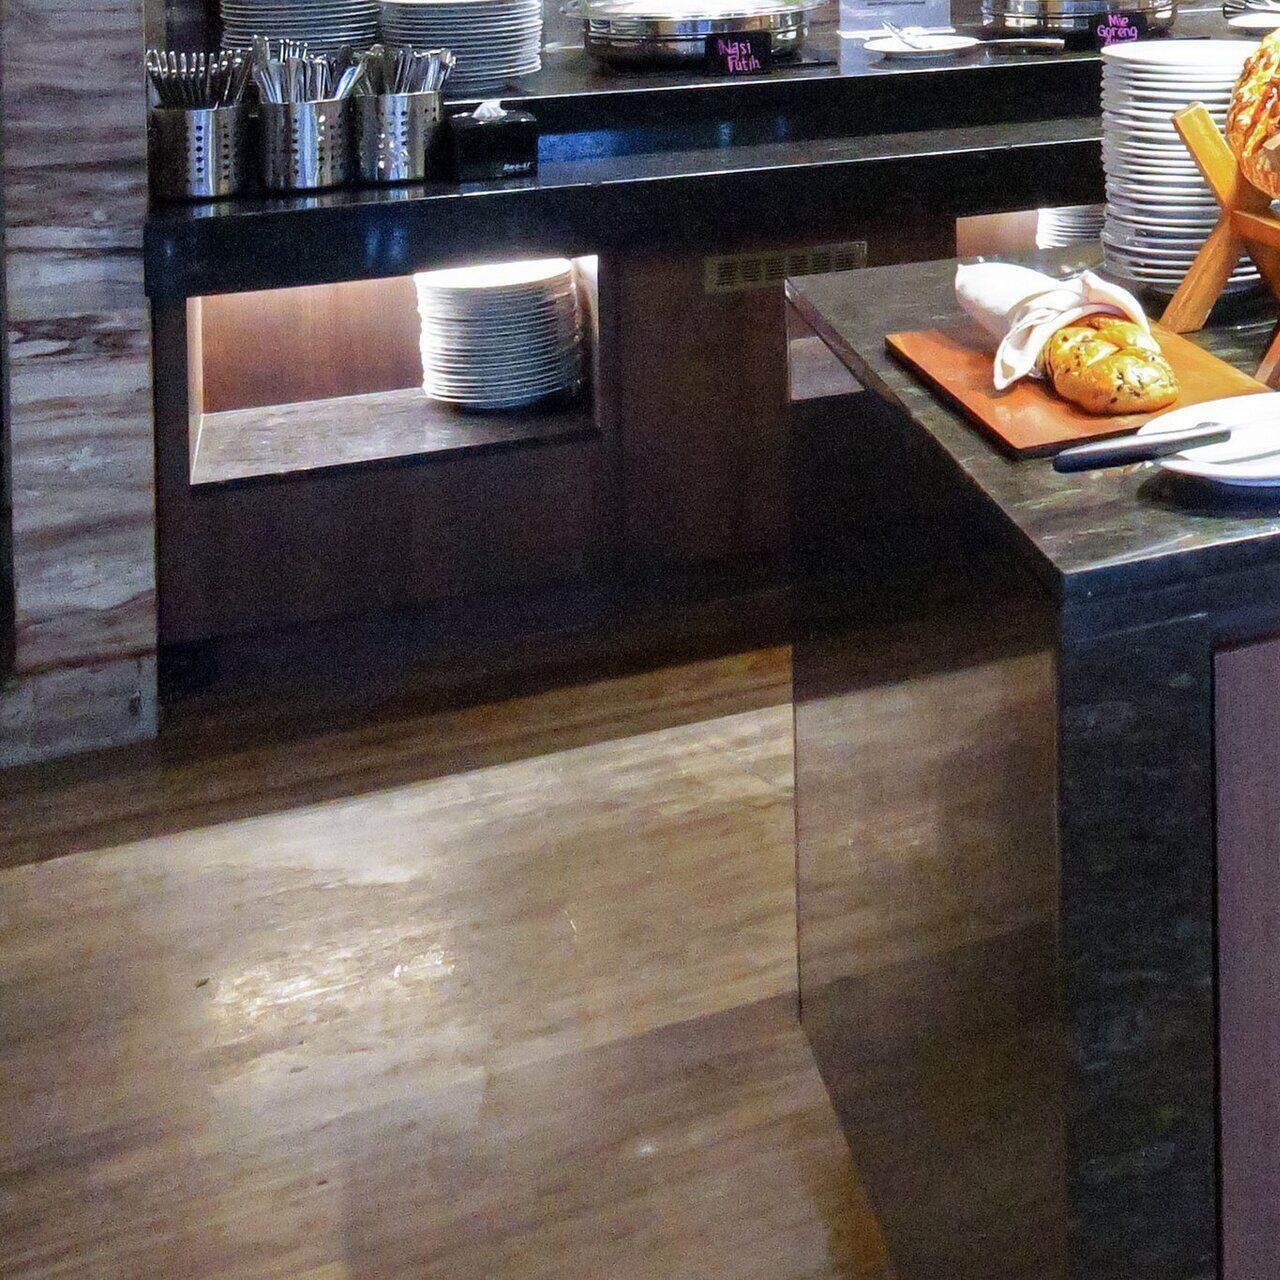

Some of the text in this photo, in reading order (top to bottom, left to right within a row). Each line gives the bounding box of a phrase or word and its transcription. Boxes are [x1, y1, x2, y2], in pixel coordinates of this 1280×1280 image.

[1108, 14, 1129, 27] Mie
[1097, 24, 1138, 40] Goreng
[718, 39, 751, 55] Nasi
[727, 54, 761, 72] Putih
